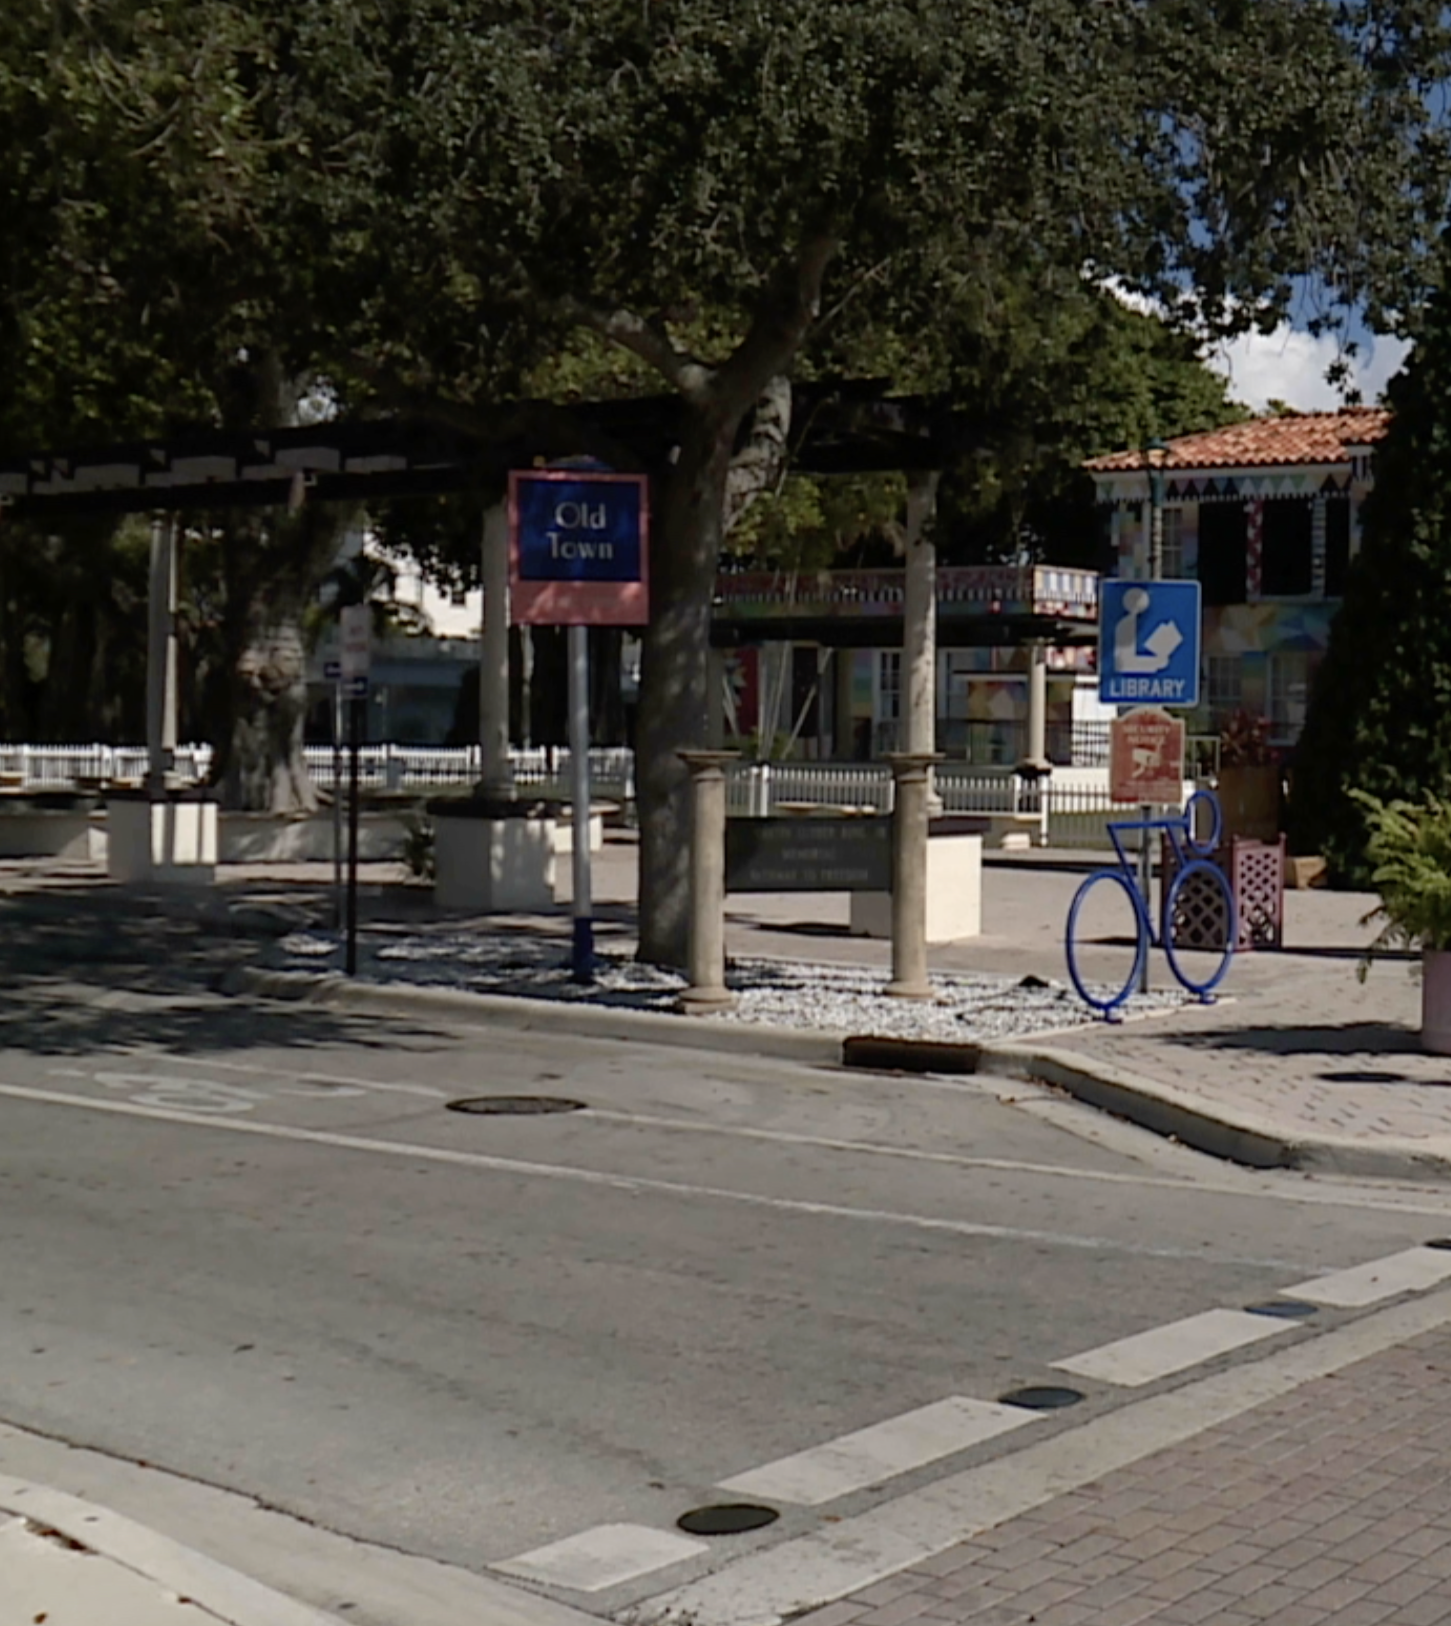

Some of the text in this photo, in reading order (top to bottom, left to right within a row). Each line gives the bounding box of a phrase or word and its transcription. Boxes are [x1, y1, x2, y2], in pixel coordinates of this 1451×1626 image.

[555, 501, 606, 530] Old
[545, 531, 614, 561] Town
[1109, 677, 1185, 698] LIBRARY
